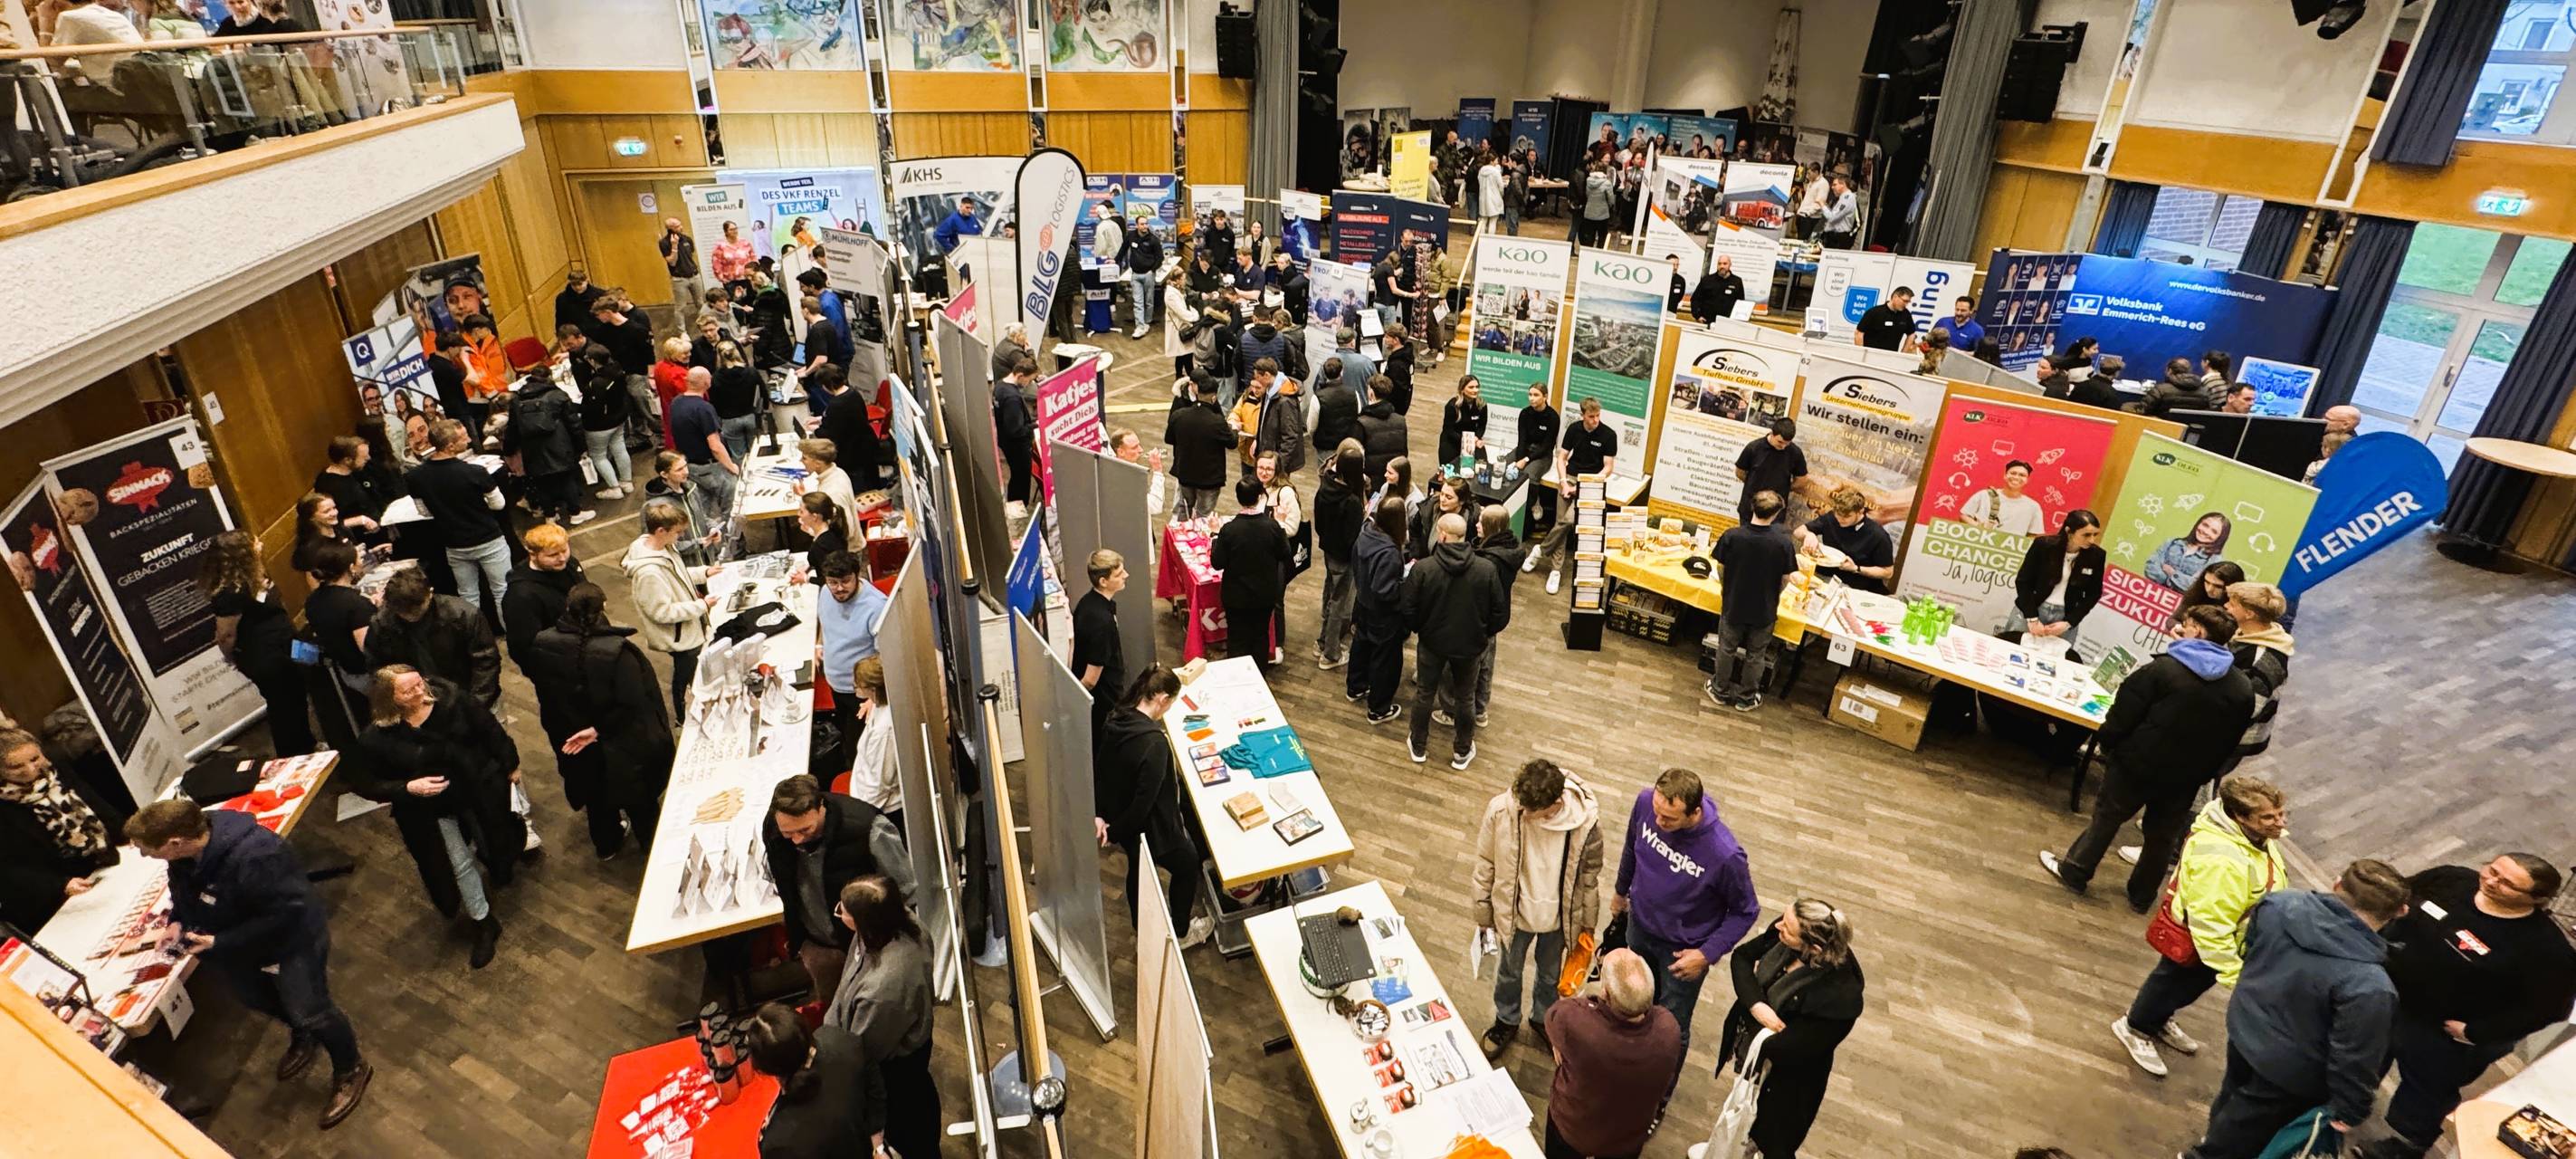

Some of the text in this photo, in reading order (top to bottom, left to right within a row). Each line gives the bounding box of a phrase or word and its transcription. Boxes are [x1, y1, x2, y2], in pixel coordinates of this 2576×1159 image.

[913, 168, 942, 181] KHS
[1760, 168, 1789, 177] deconta
[708, 194, 726, 203] WIR
[761, 188, 841, 200] DES VKF RENZEL
[1049, 167, 1076, 229] LOGISTICS
[696, 203, 739, 213] BILDEN AUS
[781, 201, 820, 214] TEAMS
[832, 233, 869, 246] MÜHLHOFF
[1499, 246, 1548, 263] kao
[1314, 265, 1330, 274] TRO
[1593, 259, 1654, 284] kao
[1026, 251, 1060, 322] BLG
[2169, 280, 2266, 302] www.dervolksbanker.de
[2106, 296, 2163, 312] Volksbank
[2102, 309, 2206, 331] Emmerich-Rees eG
[357, 341, 371, 360] Q
[399, 357, 425, 379] DICH
[1474, 354, 1542, 370] WIR BILDEN AUS
[1712, 356, 1760, 378] Siebers
[1703, 369, 1765, 388] Tiefbau GmbH
[1045, 378, 1097, 417] Katjes
[1845, 383, 1898, 408] Siebers
[1825, 395, 1911, 421] Unternehmensgruppe
[1964, 412, 1983, 421] KLK
[1050, 403, 1097, 437] sucht Dich!
[1807, 404, 1832, 419] Wir
[1836, 413, 1889, 435] stellen
[1894, 428, 1924, 444] ein:
[181, 441, 195, 452] 43
[1686, 456, 1733, 473] Baugerätefüh
[2154, 454, 2174, 465] KLK
[109, 469, 172, 503] SINNACK
[1689, 481, 1731, 496] Bauzeichner
[1690, 473, 1732, 488] Elektroniker
[1670, 484, 1739, 507] Vermessungstechnik
[1682, 495, 1732, 512] Bürokaufmann
[109, 498, 198, 540] BACKSPEZIALITÄTEN
[1932, 520, 2034, 554] BOCK AU
[2295, 490, 2423, 573] FLENDER
[140, 532, 196, 563] ZUKUNFT
[1927, 540, 2021, 572] CHANCE
[117, 552, 180, 588] GEBACKEN
[1970, 561, 2018, 595] logisc
[1199, 607, 1228, 632] Ka
[1834, 642, 1847, 653] 63
[1641, 821, 1705, 878] Wrangler
[171, 991, 183, 1013] 41
